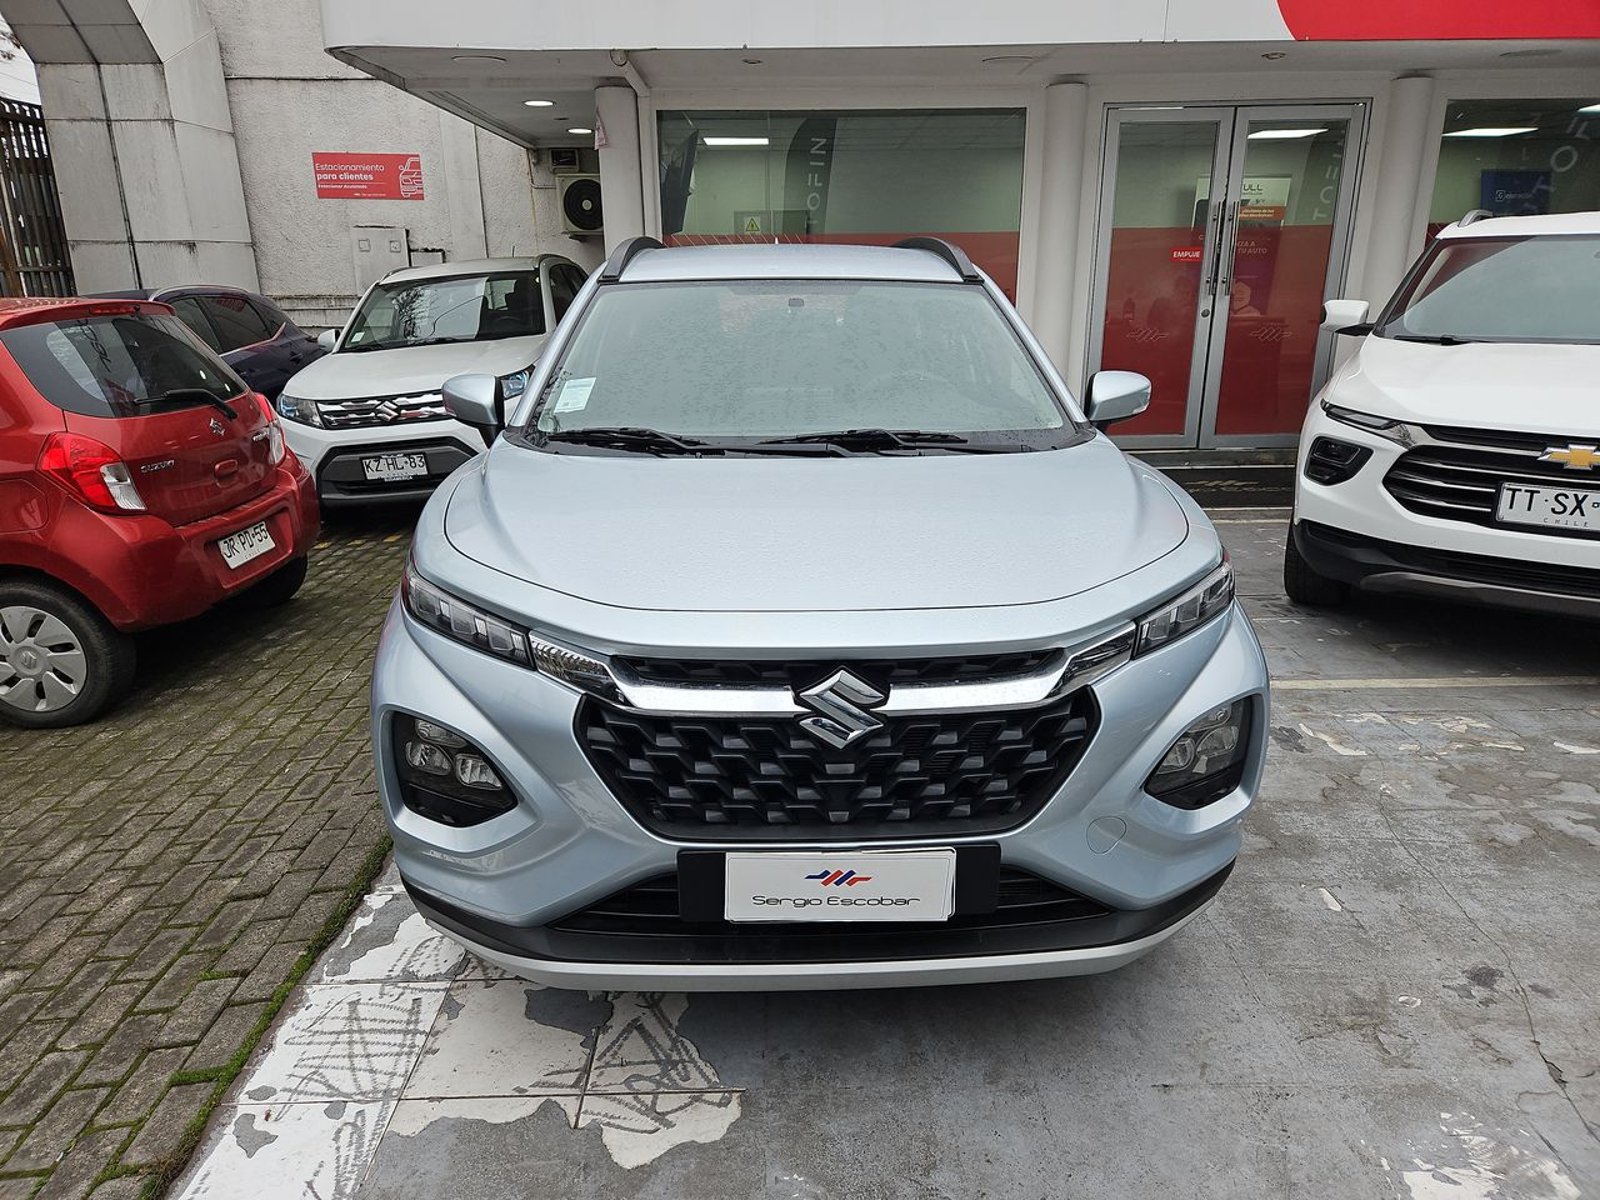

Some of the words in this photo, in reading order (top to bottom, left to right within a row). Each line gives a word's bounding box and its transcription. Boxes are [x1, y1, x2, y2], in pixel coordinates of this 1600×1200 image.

[315, 163, 385, 172] Estacionamiento
[316, 173, 337, 181] para
[339, 172, 374, 181] clientes
[1173, 250, 1201, 258] EMPUJE
[1543, 517, 1590, 528] CHILE
[752, 895, 822, 908] Sergio
[826, 895, 920, 907] Escobar
